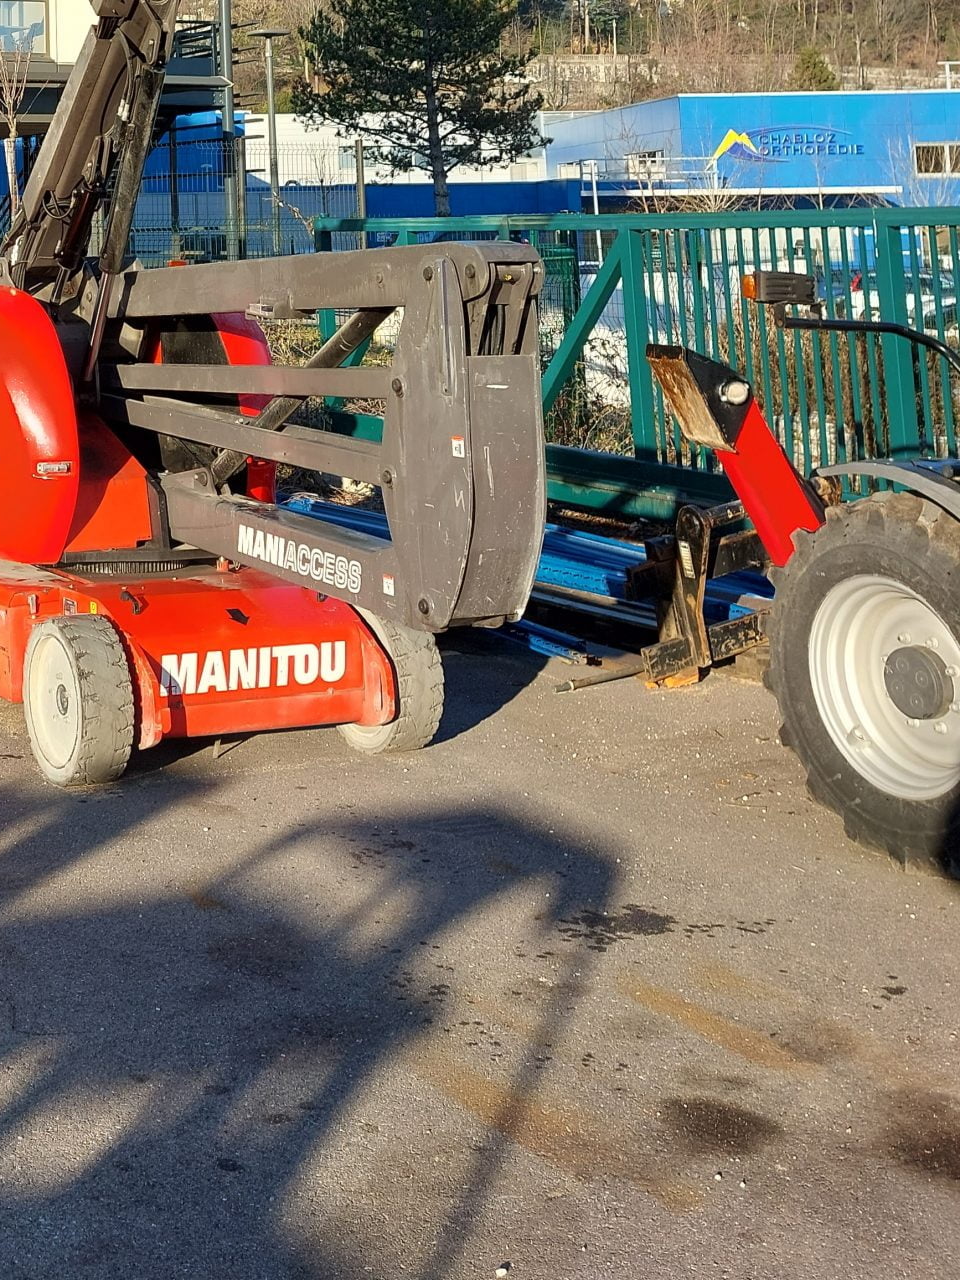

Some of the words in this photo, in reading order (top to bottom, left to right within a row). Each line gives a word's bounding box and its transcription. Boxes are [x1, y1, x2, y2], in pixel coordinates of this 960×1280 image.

[758, 144, 865, 156] ORTHOPEDIE
[237, 524, 362, 594] MANIACCESS
[159, 640, 347, 698] MANITOU
